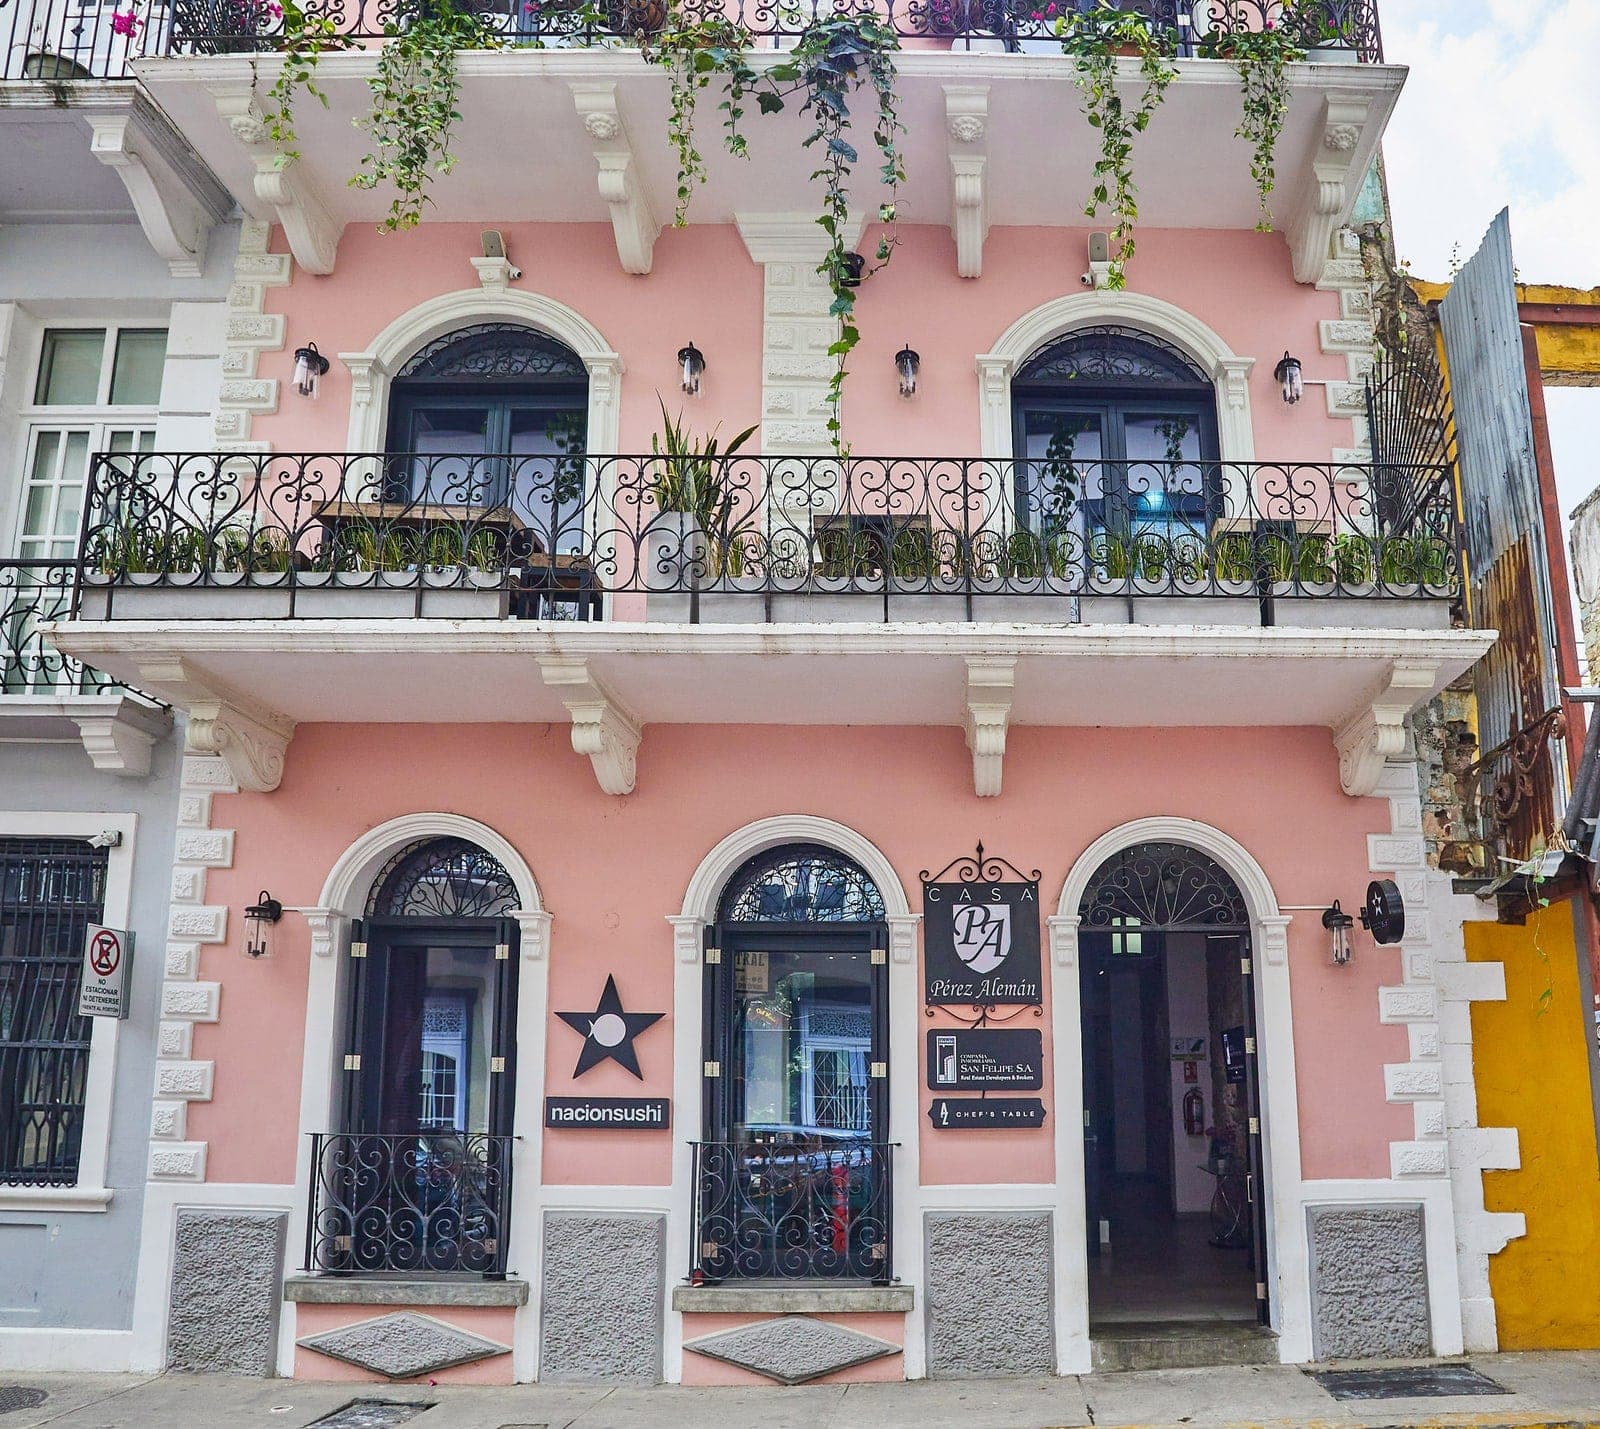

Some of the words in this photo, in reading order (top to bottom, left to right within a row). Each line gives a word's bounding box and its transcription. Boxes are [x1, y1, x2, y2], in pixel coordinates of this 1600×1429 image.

[928, 888, 1034, 902] CASA
[953, 904, 1008, 964] PA
[85, 986, 118, 995] ESTACIONAR
[930, 979, 973, 997] Pérez
[975, 977, 1036, 999] Alemán
[88, 995, 119, 1005] DETENERSE
[960, 1064, 980, 1073] SAN
[982, 1064, 1014, 1073] FELIPE
[551, 1104, 662, 1122] nacionsushi
